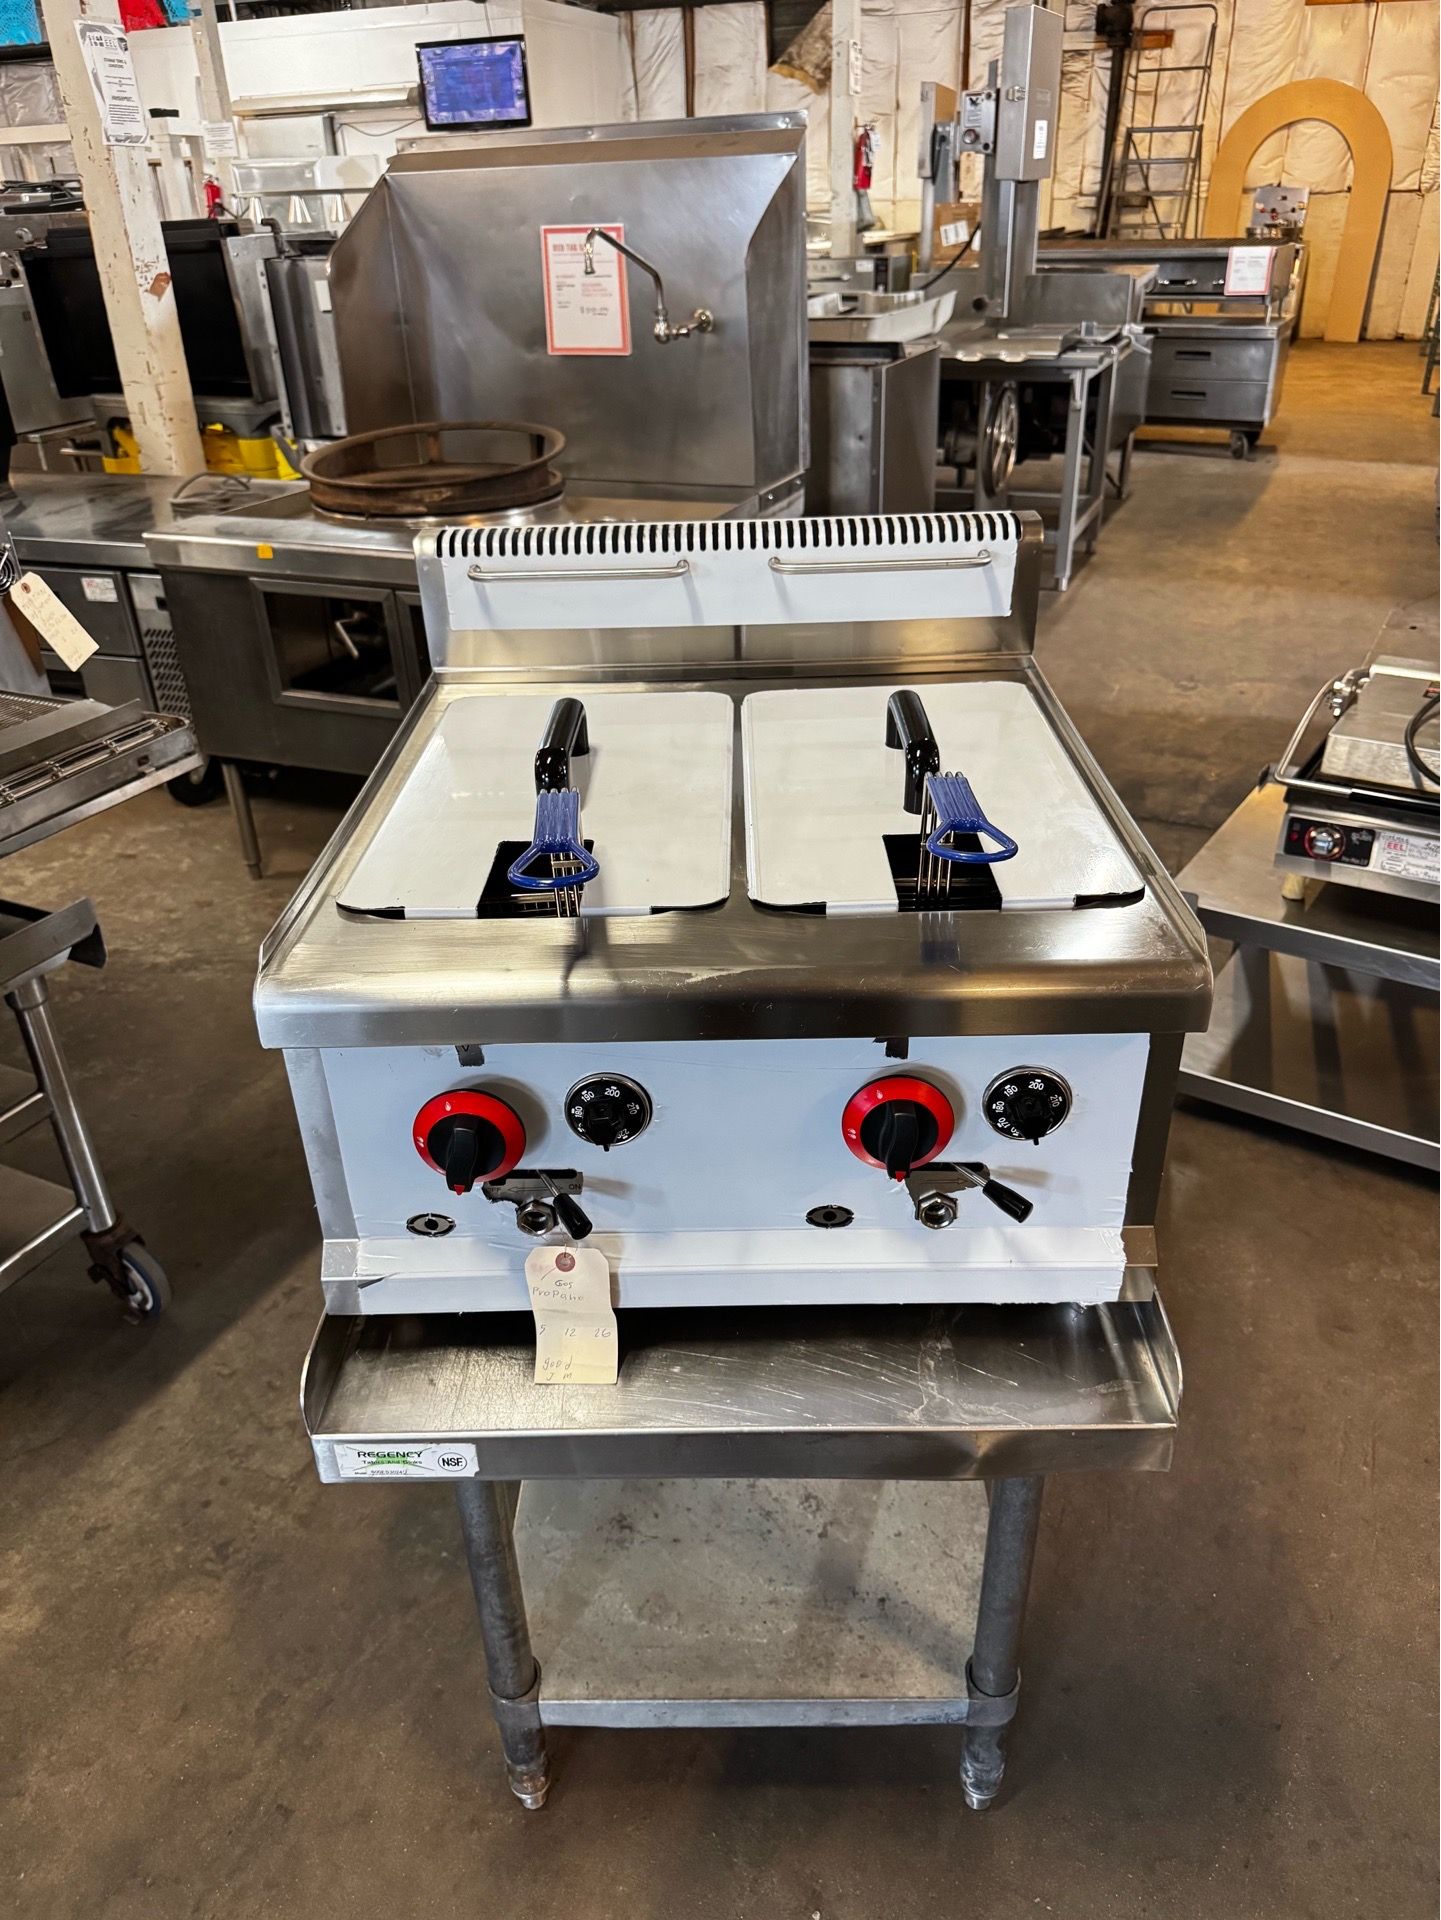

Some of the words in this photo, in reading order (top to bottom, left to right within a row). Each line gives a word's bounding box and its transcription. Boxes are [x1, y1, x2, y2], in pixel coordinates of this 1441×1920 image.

[1028, 1081, 1045, 1091] 200
[604, 1087, 621, 1098] 200
[1049, 1094, 1060, 1108] 210
[574, 1105, 583, 1118] 180
[626, 1102, 638, 1115] 210
[995, 1101, 1005, 1113] 180
[998, 1117, 1011, 1129] 170
[568, 1183, 581, 1191] ON
[564, 1328, 576, 1337] 12
[594, 1328, 611, 1338] 26
[441, 1457, 463, 1467] NSF
